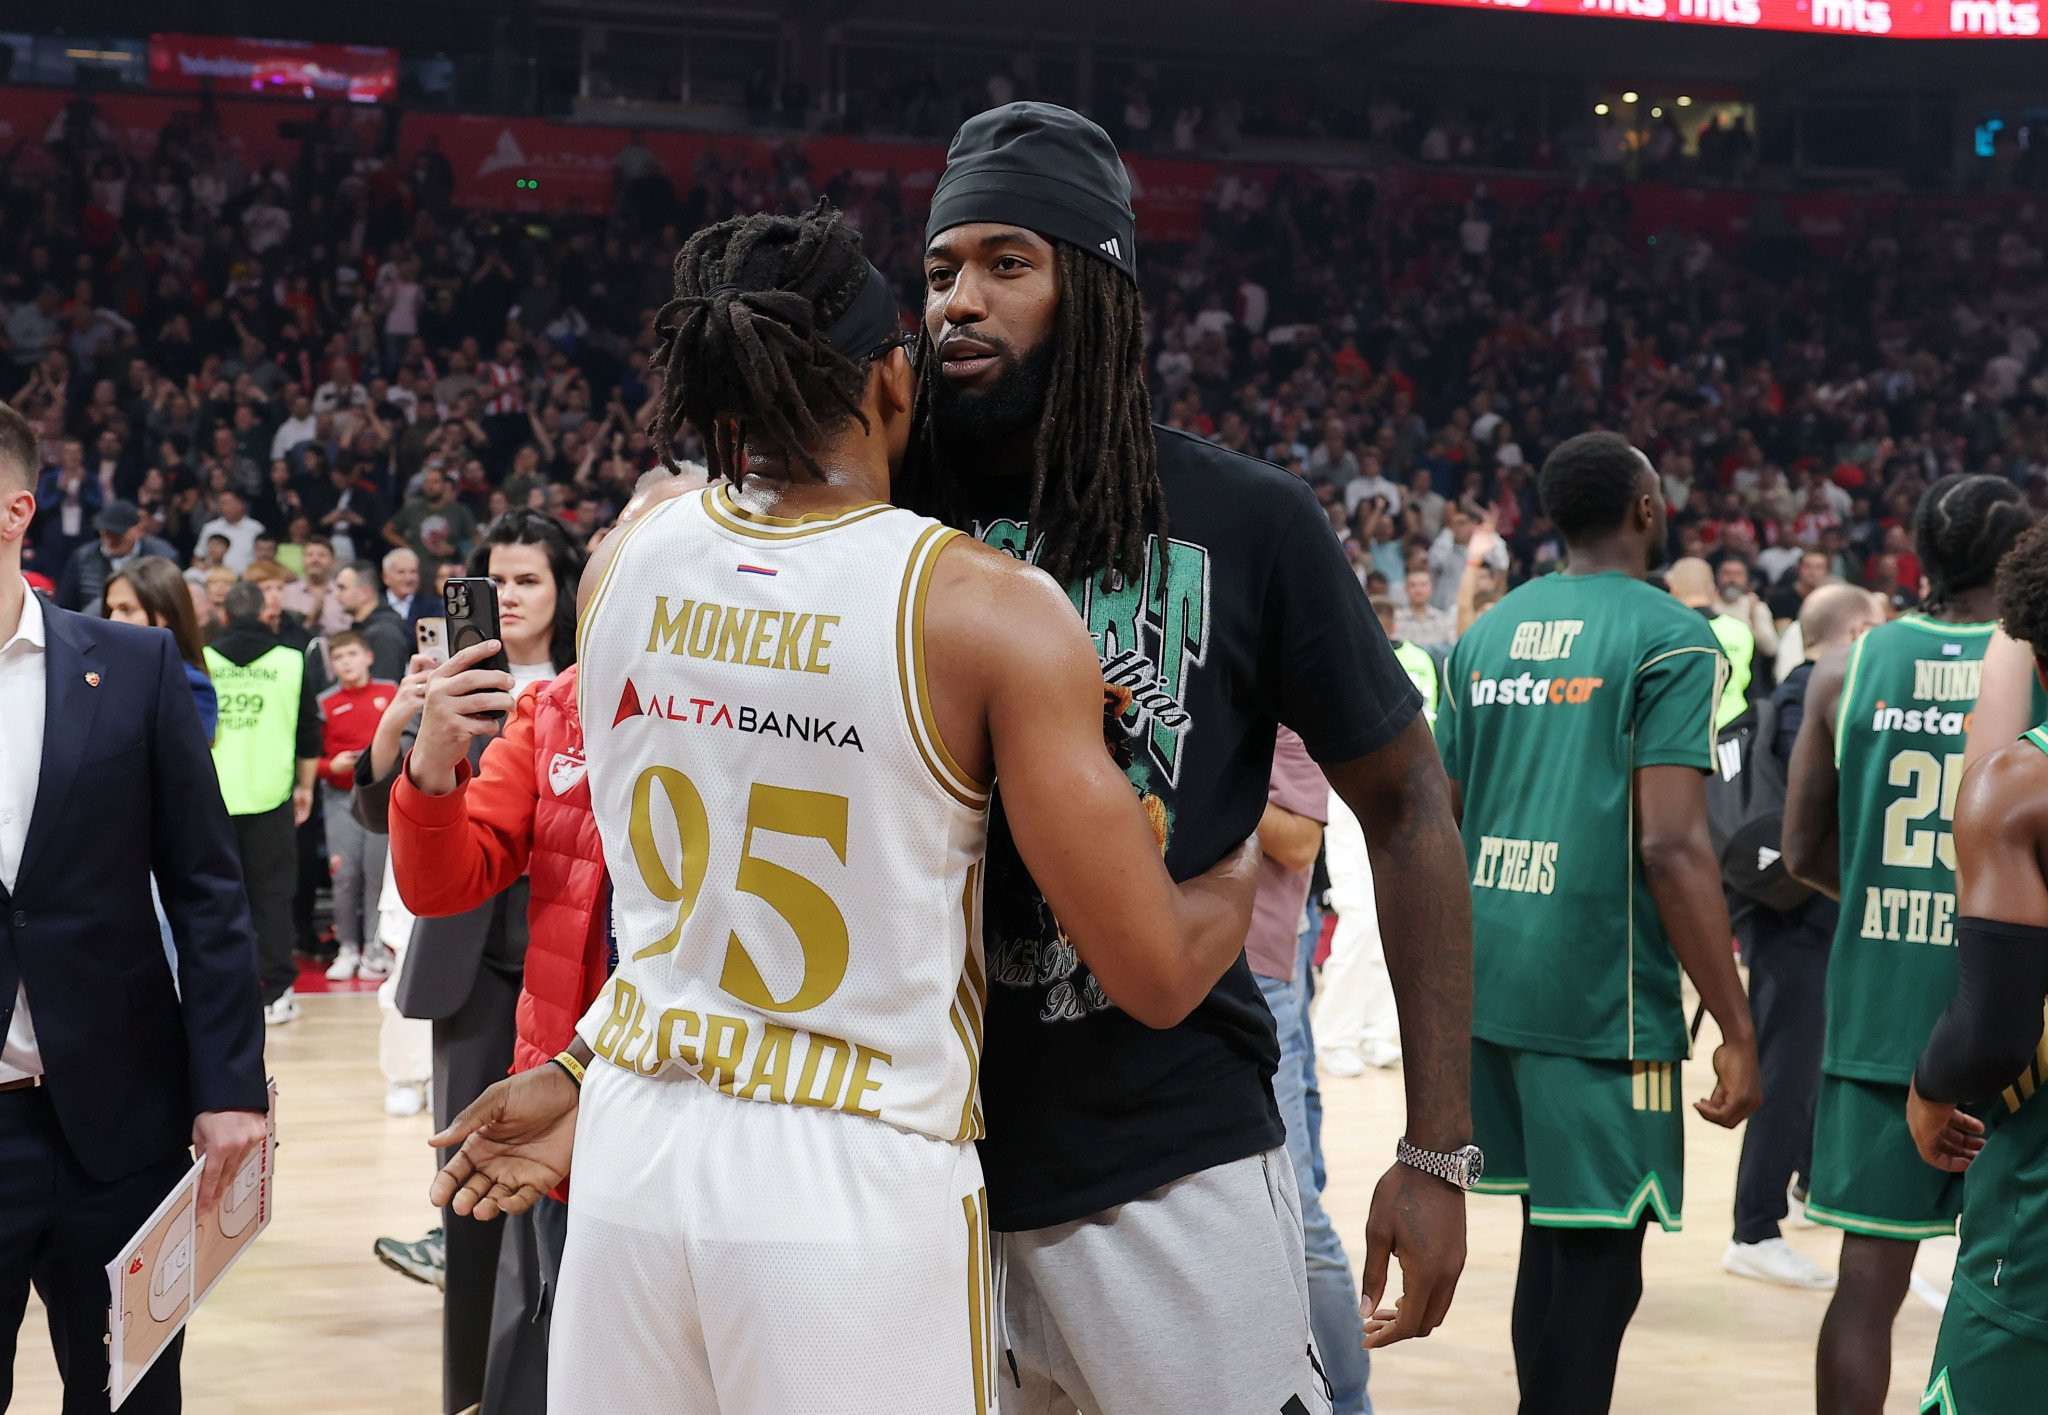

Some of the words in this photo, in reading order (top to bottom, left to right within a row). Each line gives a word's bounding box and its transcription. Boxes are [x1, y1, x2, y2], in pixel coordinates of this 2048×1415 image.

[1810, 0, 1893, 35] mts
[1948, 0, 2042, 37] mts
[645, 595, 841, 675] MONEKE
[1509, 619, 1584, 661] GRANT
[218, 693, 264, 713] 299
[1471, 671, 1604, 707] instacar
[646, 694, 865, 753] ALTABANKA
[628, 765, 850, 1013] 95
[1472, 835, 1559, 895] ATHENS
[1860, 886, 1959, 948] ATHE
[593, 977, 893, 1119] BELGRADE
